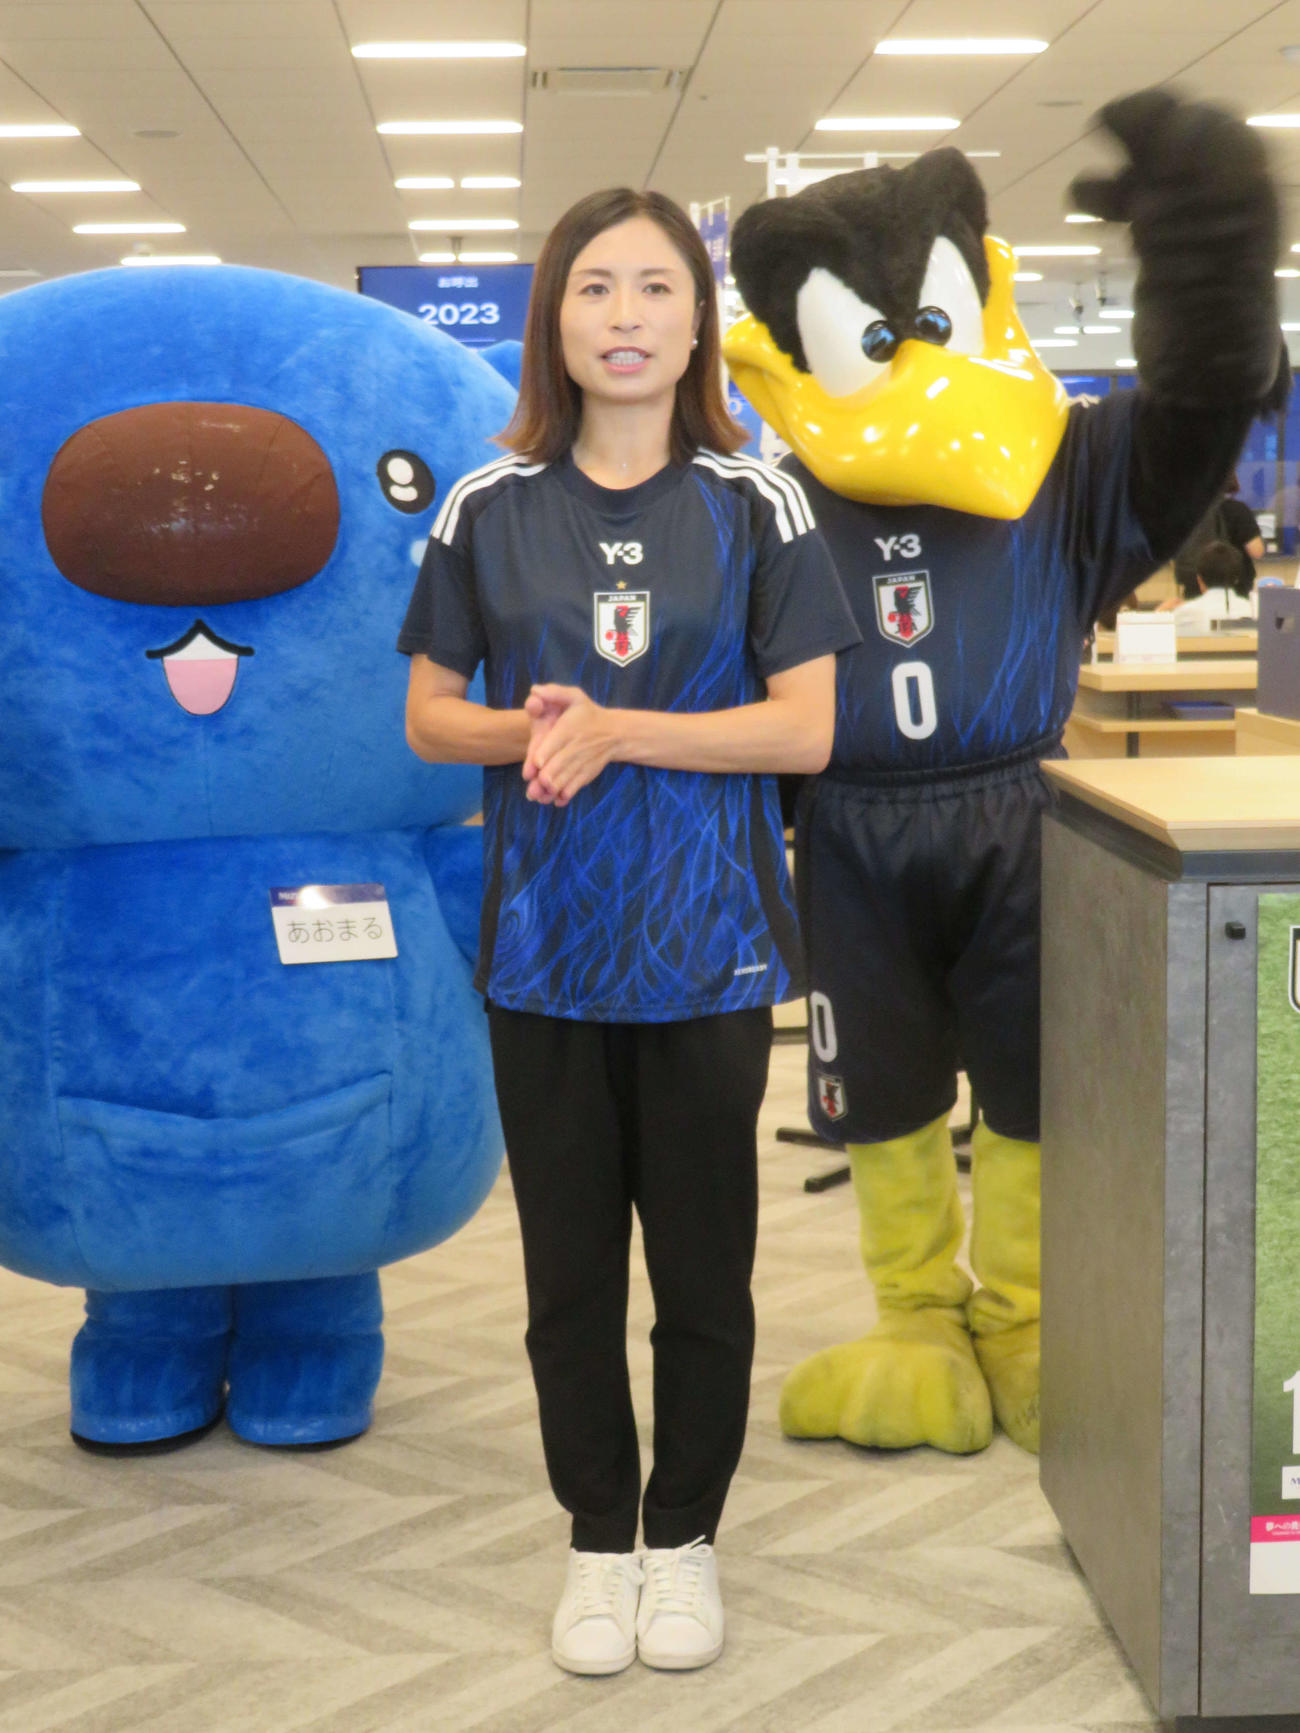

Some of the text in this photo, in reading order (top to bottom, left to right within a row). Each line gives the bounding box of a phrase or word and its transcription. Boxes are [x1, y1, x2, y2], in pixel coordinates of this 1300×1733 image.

[418, 302, 500, 325] 2023
[599, 541, 643, 565] Y-3
[887, 575, 916, 584] JAPAN
[891, 661, 938, 740] 0
[287, 917, 383, 944] あおまる
[811, 992, 837, 1062] 0
